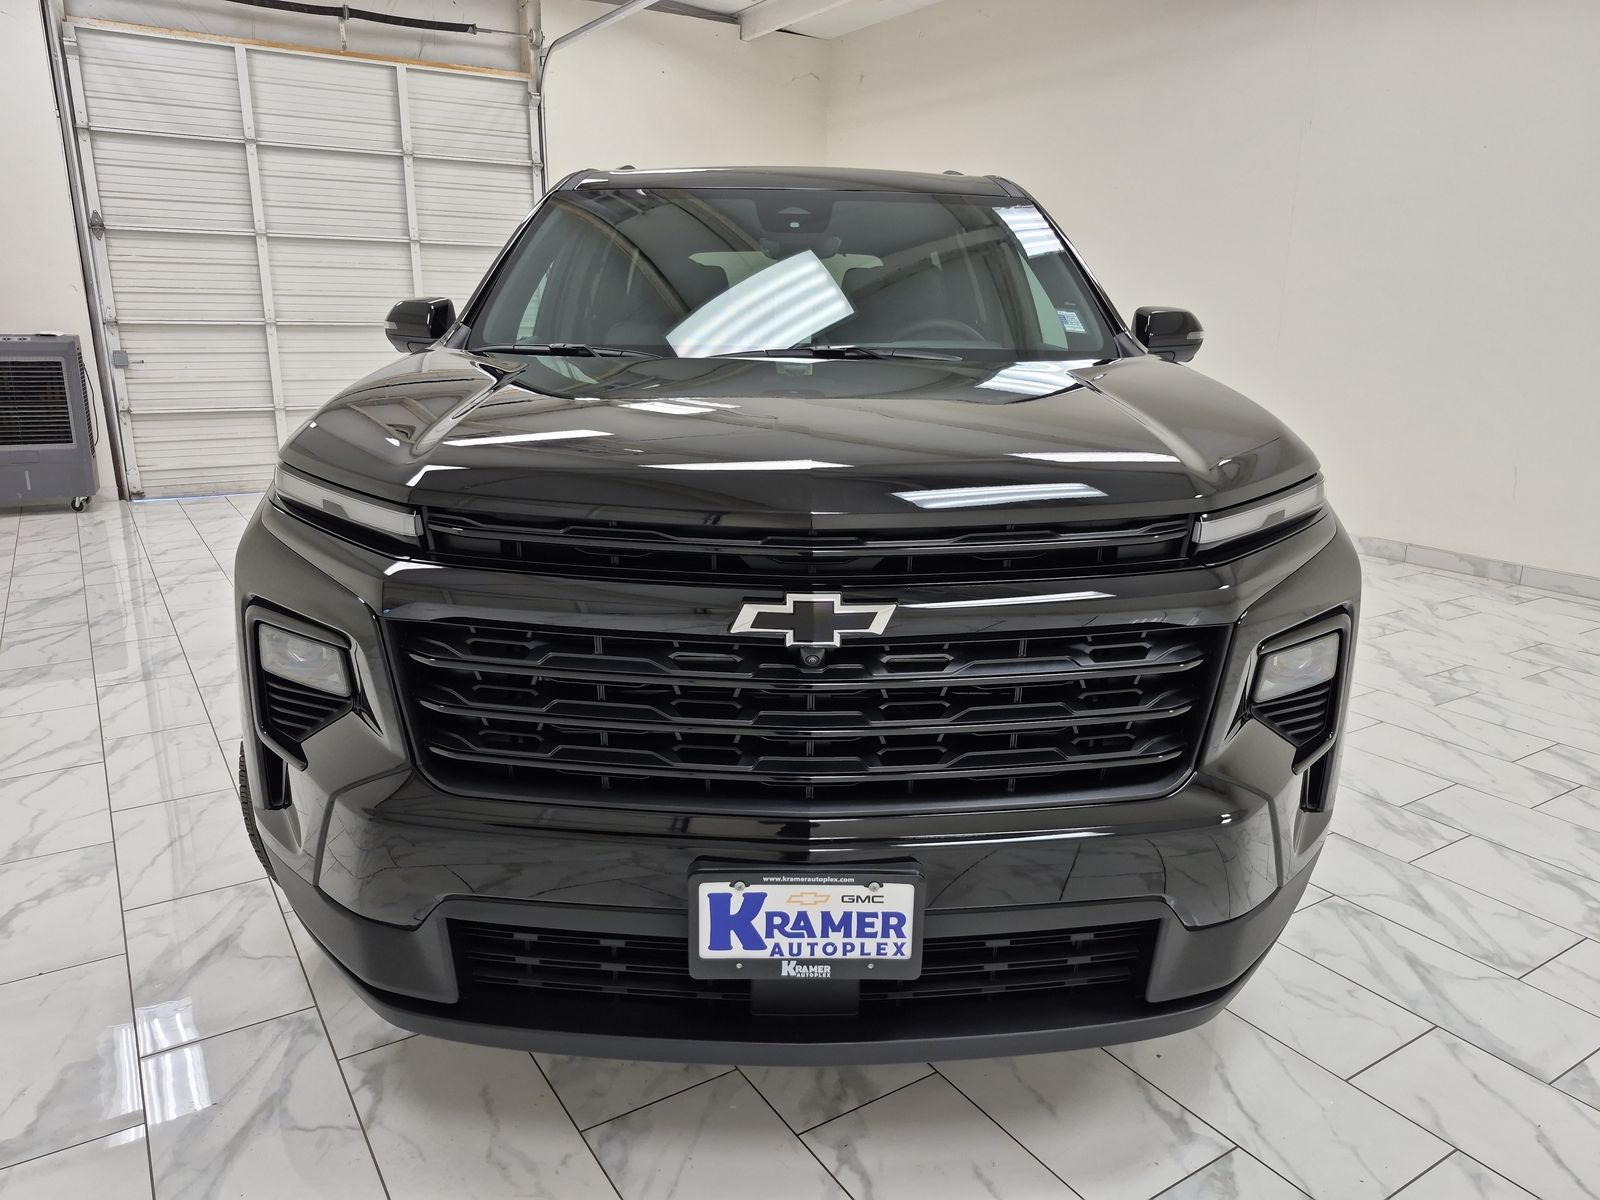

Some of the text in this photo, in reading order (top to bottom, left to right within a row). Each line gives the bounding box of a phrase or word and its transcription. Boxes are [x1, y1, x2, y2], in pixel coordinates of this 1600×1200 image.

[841, 894, 885, 904] GMC
[707, 891, 907, 951] KRAMER
[769, 942, 906, 957] AUTOPLEX
[781, 960, 831, 976] KRAMER
